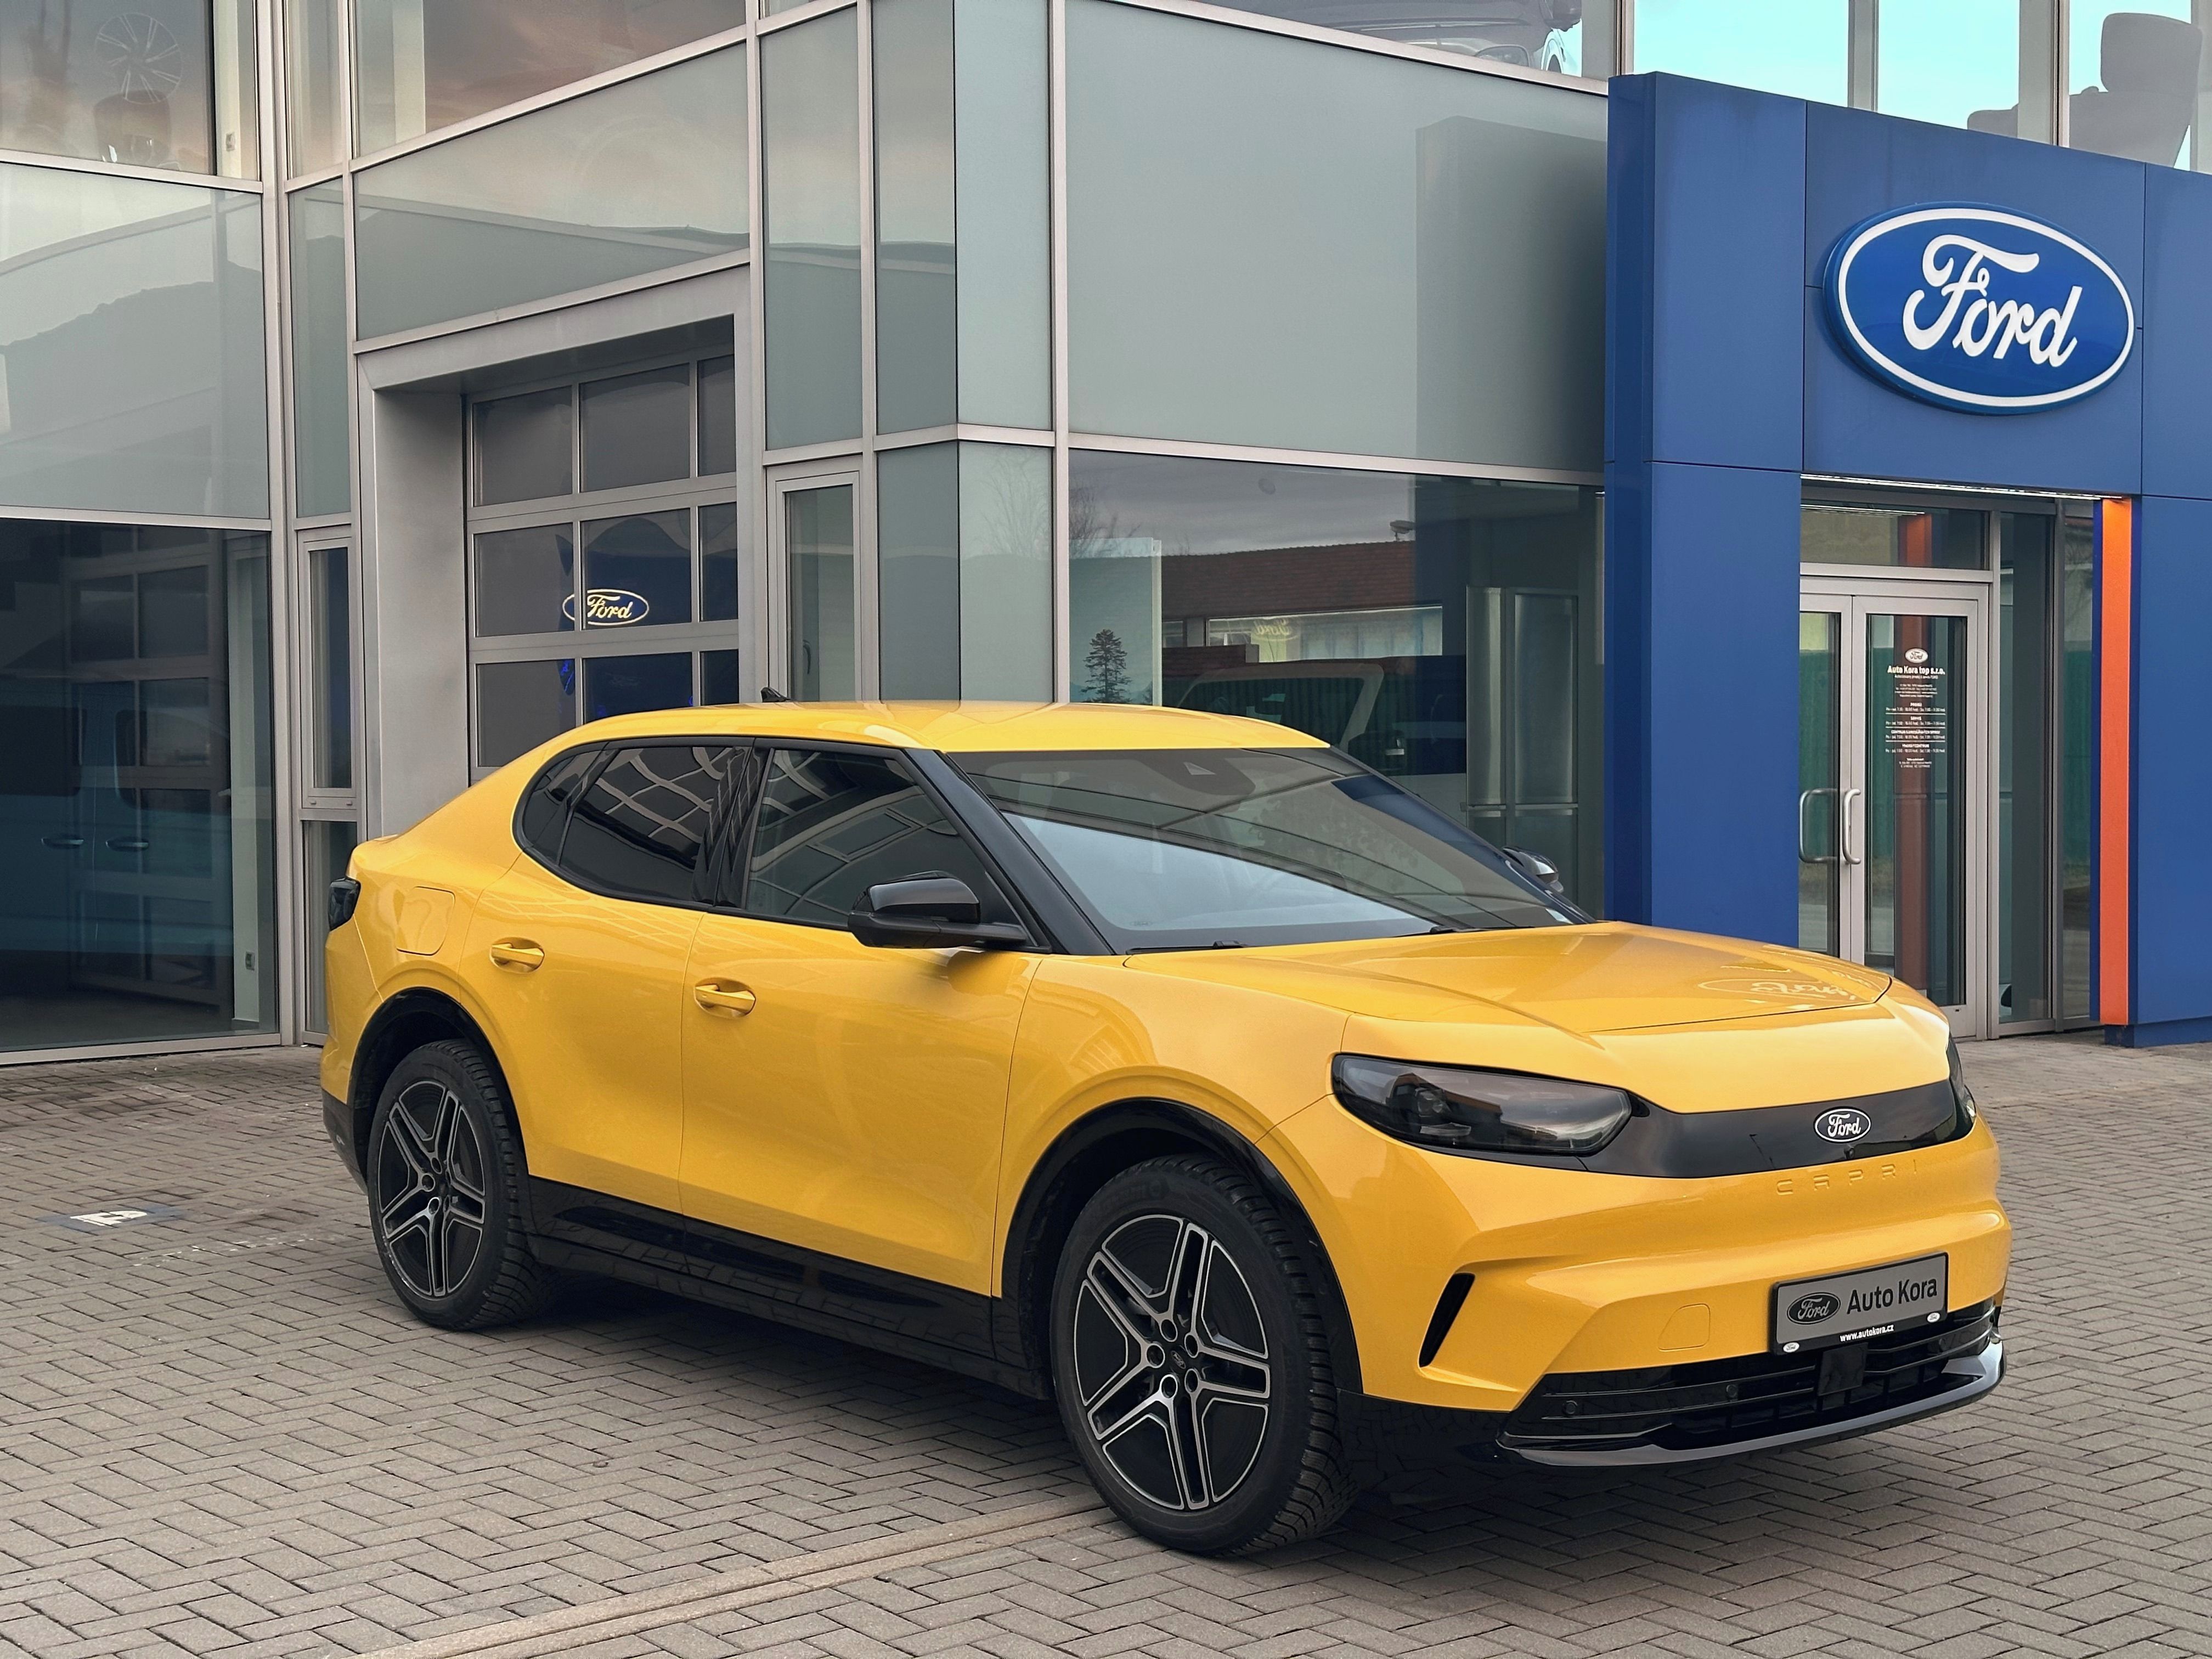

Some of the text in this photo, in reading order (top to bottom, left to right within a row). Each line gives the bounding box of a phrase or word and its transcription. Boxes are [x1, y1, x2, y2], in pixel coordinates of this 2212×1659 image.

[1903, 234, 2083, 368] Ford
[587, 594, 633, 619] Ford
[1887, 665, 1903, 674] Auto
[1904, 665, 1918, 674] Kora
[1919, 666, 1930, 675] top
[1827, 1113, 1861, 1137] Ford
[1776, 1159, 1917, 1196] CAPRI
[1797, 1278, 1937, 1319] Ford Auto Kora
[1839, 1324, 1894, 1342] www.autokora.cz
